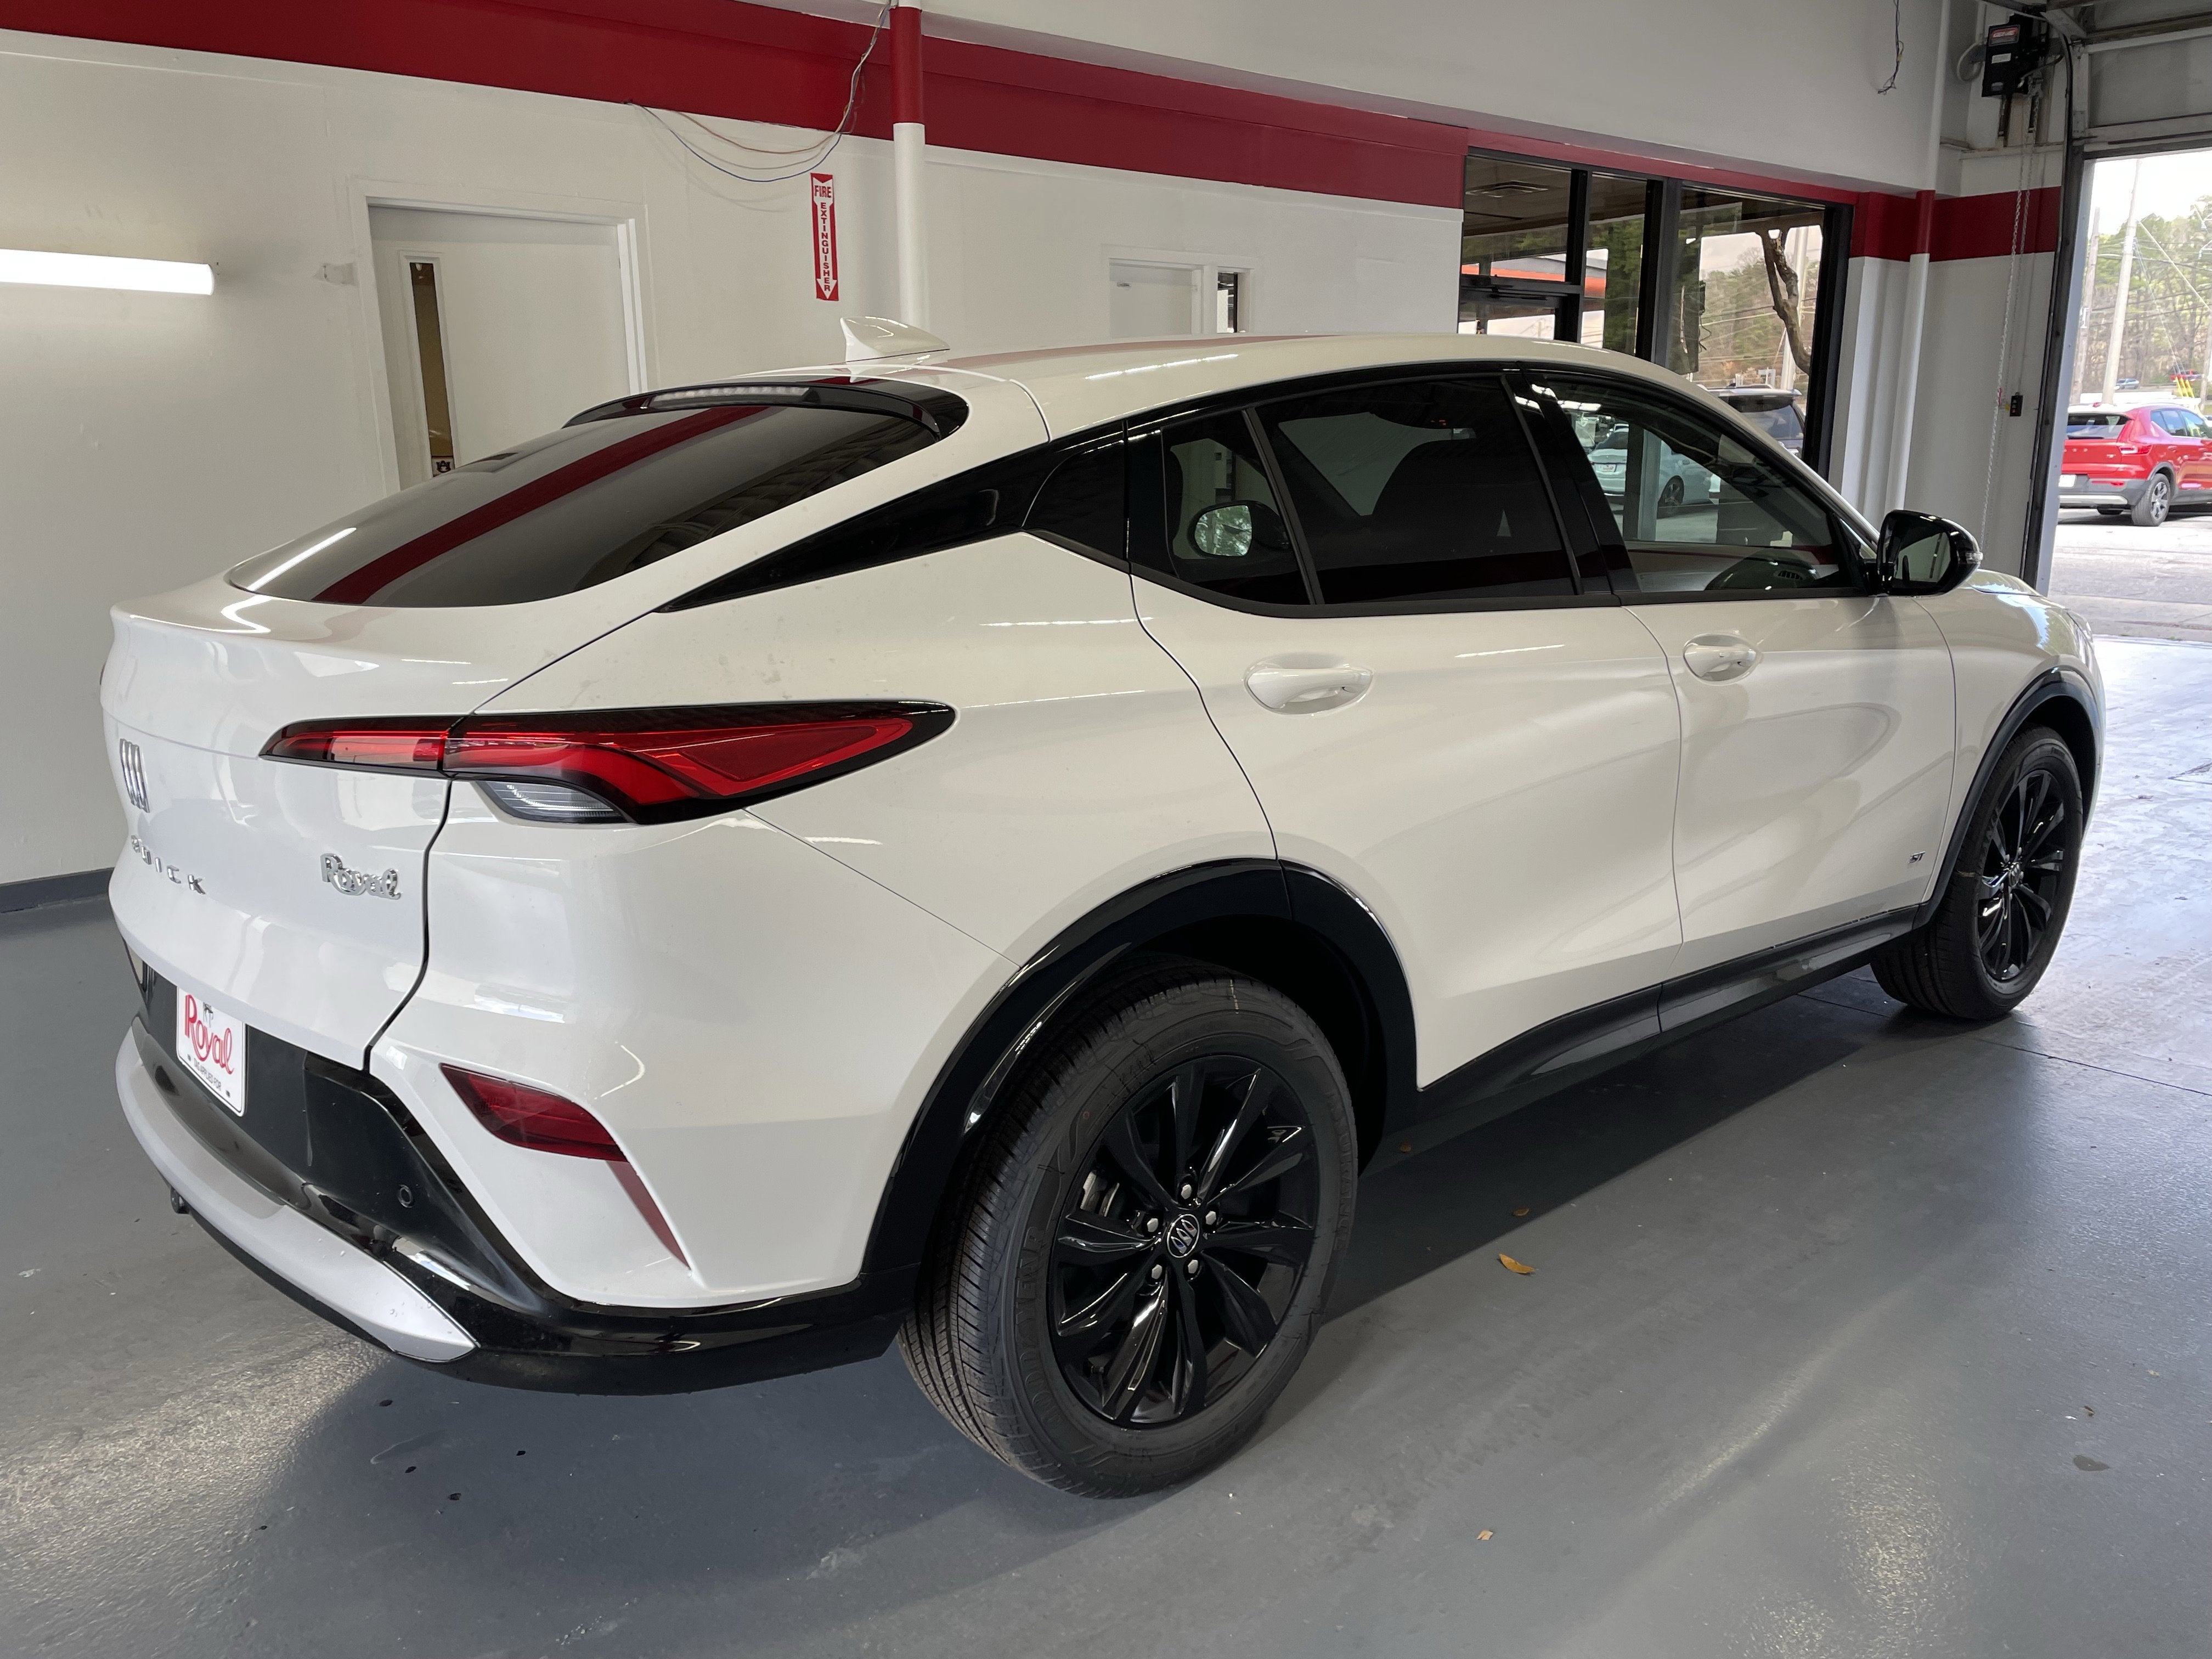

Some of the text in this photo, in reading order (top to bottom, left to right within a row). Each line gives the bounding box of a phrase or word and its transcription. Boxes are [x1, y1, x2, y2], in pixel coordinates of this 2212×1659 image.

[814, 185, 832, 198] FIRE
[820, 202, 831, 291] EXTINGUISHER
[132, 835, 206, 894] BUICK
[320, 853, 402, 900] Royal
[185, 994, 235, 1075] Royal
